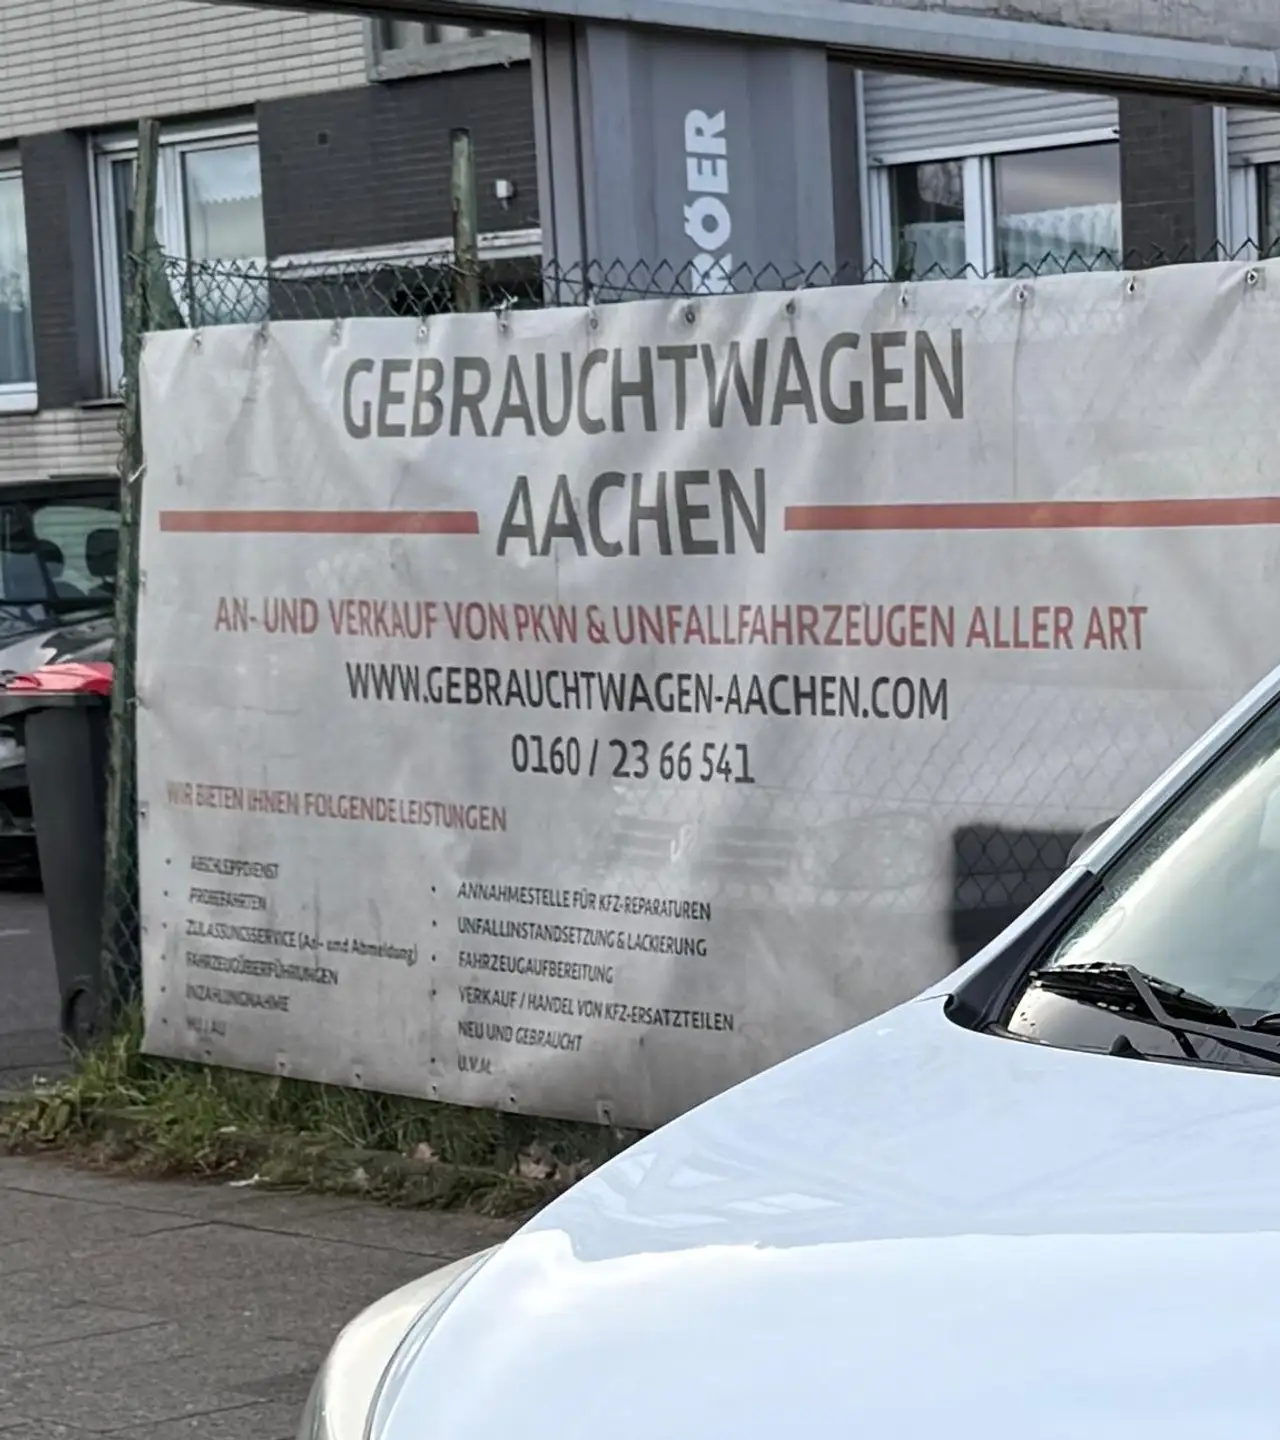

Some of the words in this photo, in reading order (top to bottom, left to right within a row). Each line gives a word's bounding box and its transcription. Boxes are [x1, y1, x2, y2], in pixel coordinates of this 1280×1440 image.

[342, 328, 965, 439] GEBRAUCHTWAGEN
[496, 468, 766, 557] AACHEN
[214, 598, 257, 632] AN-
[264, 597, 319, 635] UND
[328, 599, 438, 640] VERKAUF
[444, 601, 506, 641] VON
[516, 603, 578, 643] PKW
[587, 605, 609, 645] &
[613, 604, 956, 648] UNFALLFAHRZEUGEN
[965, 605, 1074, 650] ALLER
[1083, 605, 1148, 650] ART
[346, 661, 949, 721] WWW.GEBRAUCHTWAGEN-AACHEN.COM
[511, 733, 580, 776] 0160
[588, 738, 599, 777] /
[608, 739, 648, 780] 23
[658, 741, 693, 781] 66
[700, 742, 755, 785] 541
[166, 780, 193, 806] WIR
[196, 783, 243, 811] BIETEN
[247, 788, 299, 816] IHNEN
[304, 791, 397, 824] FOLGENDE
[400, 796, 507, 833] LEISTUNGEN
[457, 881, 571, 909] ANNAHMESTELLE
[573, 888, 597, 911] FÜR
[599, 892, 712, 922] KFZ-REPARATUREN
[457, 916, 616, 950] UNFALLINSTANDSETZUNG
[627, 932, 708, 958] LACKIERUNG
[458, 951, 614, 984] FAHRZEUGAUFBEREITUNG
[458, 985, 517, 1009] VERKAUF
[527, 991, 575, 1017] HANDEL
[577, 998, 603, 1019] VON
[604, 1004, 735, 1033] KFZ-ERSATZTEILEN
[458, 1020, 485, 1041] NEU
[486, 1024, 513, 1043] UND
[515, 1026, 583, 1052] GEBRAUCHT
